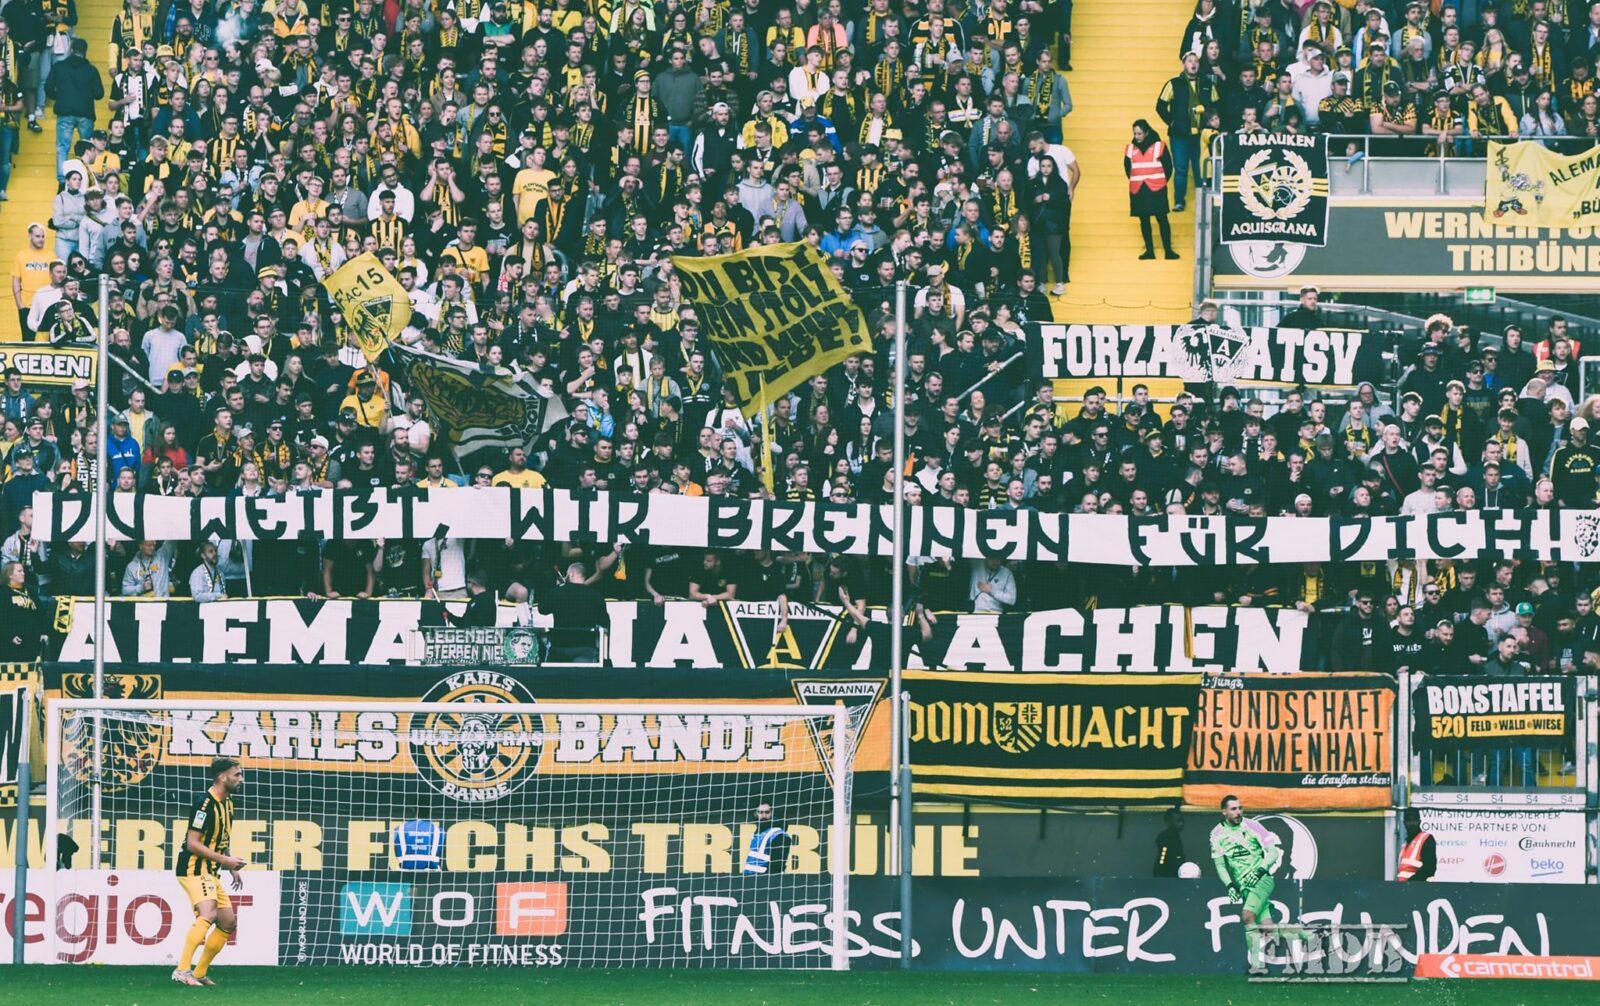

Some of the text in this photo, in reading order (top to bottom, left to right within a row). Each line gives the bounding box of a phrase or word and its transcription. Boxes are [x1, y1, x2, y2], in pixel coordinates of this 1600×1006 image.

[1238, 133, 1316, 148] RABAUKEN
[1230, 221, 1318, 237] AQUISGRANA
[1041, 324, 1179, 378] FORZA
[1242, 326, 1362, 385] ATSV
[12, 353, 92, 378] GEBEN!
[51, 490, 145, 541] DU
[510, 487, 649, 544] WIR
[707, 492, 1069, 562] BRENNEN
[1128, 512, 1270, 567] FÜR
[1330, 508, 1561, 563] DICH!
[58, 599, 724, 668] ALEMAIA
[426, 628, 504, 644] LEGENDEN
[426, 644, 505, 661] STERBEN NIE!
[446, 671, 516, 692] KARLS
[803, 684, 876, 695] ALEMANNIA
[1427, 682, 1565, 715] BOXSTAFFEL
[1197, 689, 1383, 731] REUNDSCHAFT
[168, 709, 400, 763] KARLS
[1046, 705, 1191, 750] WACHT
[1431, 715, 1562, 739] 520 FELD WALD WIESE
[553, 713, 787, 764] BANDE
[1192, 731, 1384, 772] USAMMENHALT
[440, 780, 512, 801] BANDE
[1301, 774, 1391, 788] die draußen stehen!
[1422, 793, 1434, 804] S4
[1456, 793, 1469, 804] S4
[1491, 794, 1503, 805] S4
[1526, 794, 1538, 805] S4
[1560, 795, 1573, 806] S4
[1422, 809, 1443, 819] WIR
[1447, 810, 1473, 819] SIND
[1421, 822, 1549, 833] ONLINE-PARTNER VON:
[0, 818, 322, 871] WERER
[348, 819, 611, 873] FCHS
[1479, 838, 1508, 848] Haier
[1525, 837, 1577, 849] Bauknecht
[1438, 857, 1465, 865] ARP
[1530, 858, 1565, 871] beko
[0, 874, 173, 963] egio
[639, 887, 921, 957] FITNESS
[952, 897, 1176, 962] UNTER
[341, 943, 563, 966] WORLD OF FITNESS
[1464, 959, 1593, 978] camcontrol
